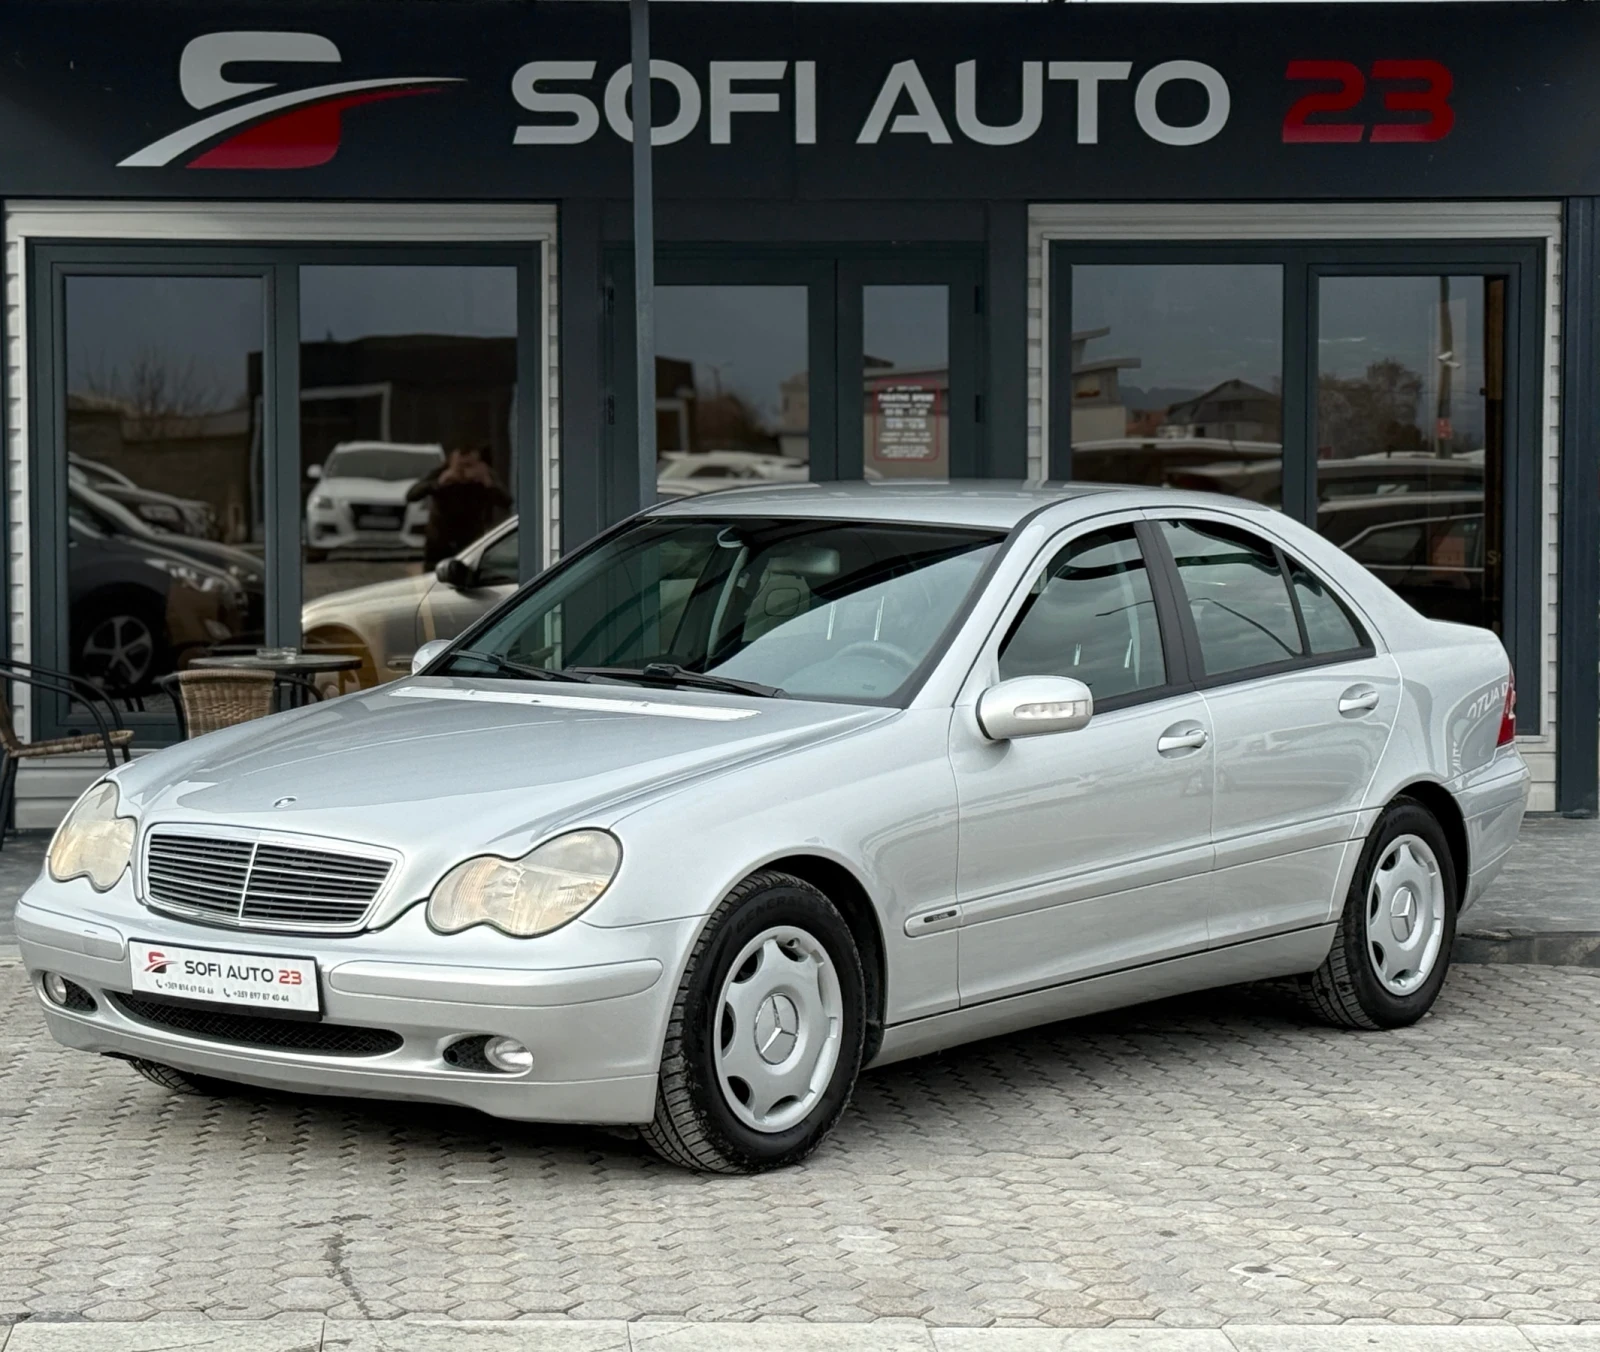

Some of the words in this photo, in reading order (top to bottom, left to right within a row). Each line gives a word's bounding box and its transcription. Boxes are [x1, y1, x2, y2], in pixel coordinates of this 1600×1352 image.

[512, 60, 816, 145] SOFI
[856, 60, 1230, 145] AUTO
[1283, 61, 1453, 142] 23
[184, 960, 222, 977] SOFI
[226, 967, 274, 983] AUTO
[278, 970, 302, 985] 23
